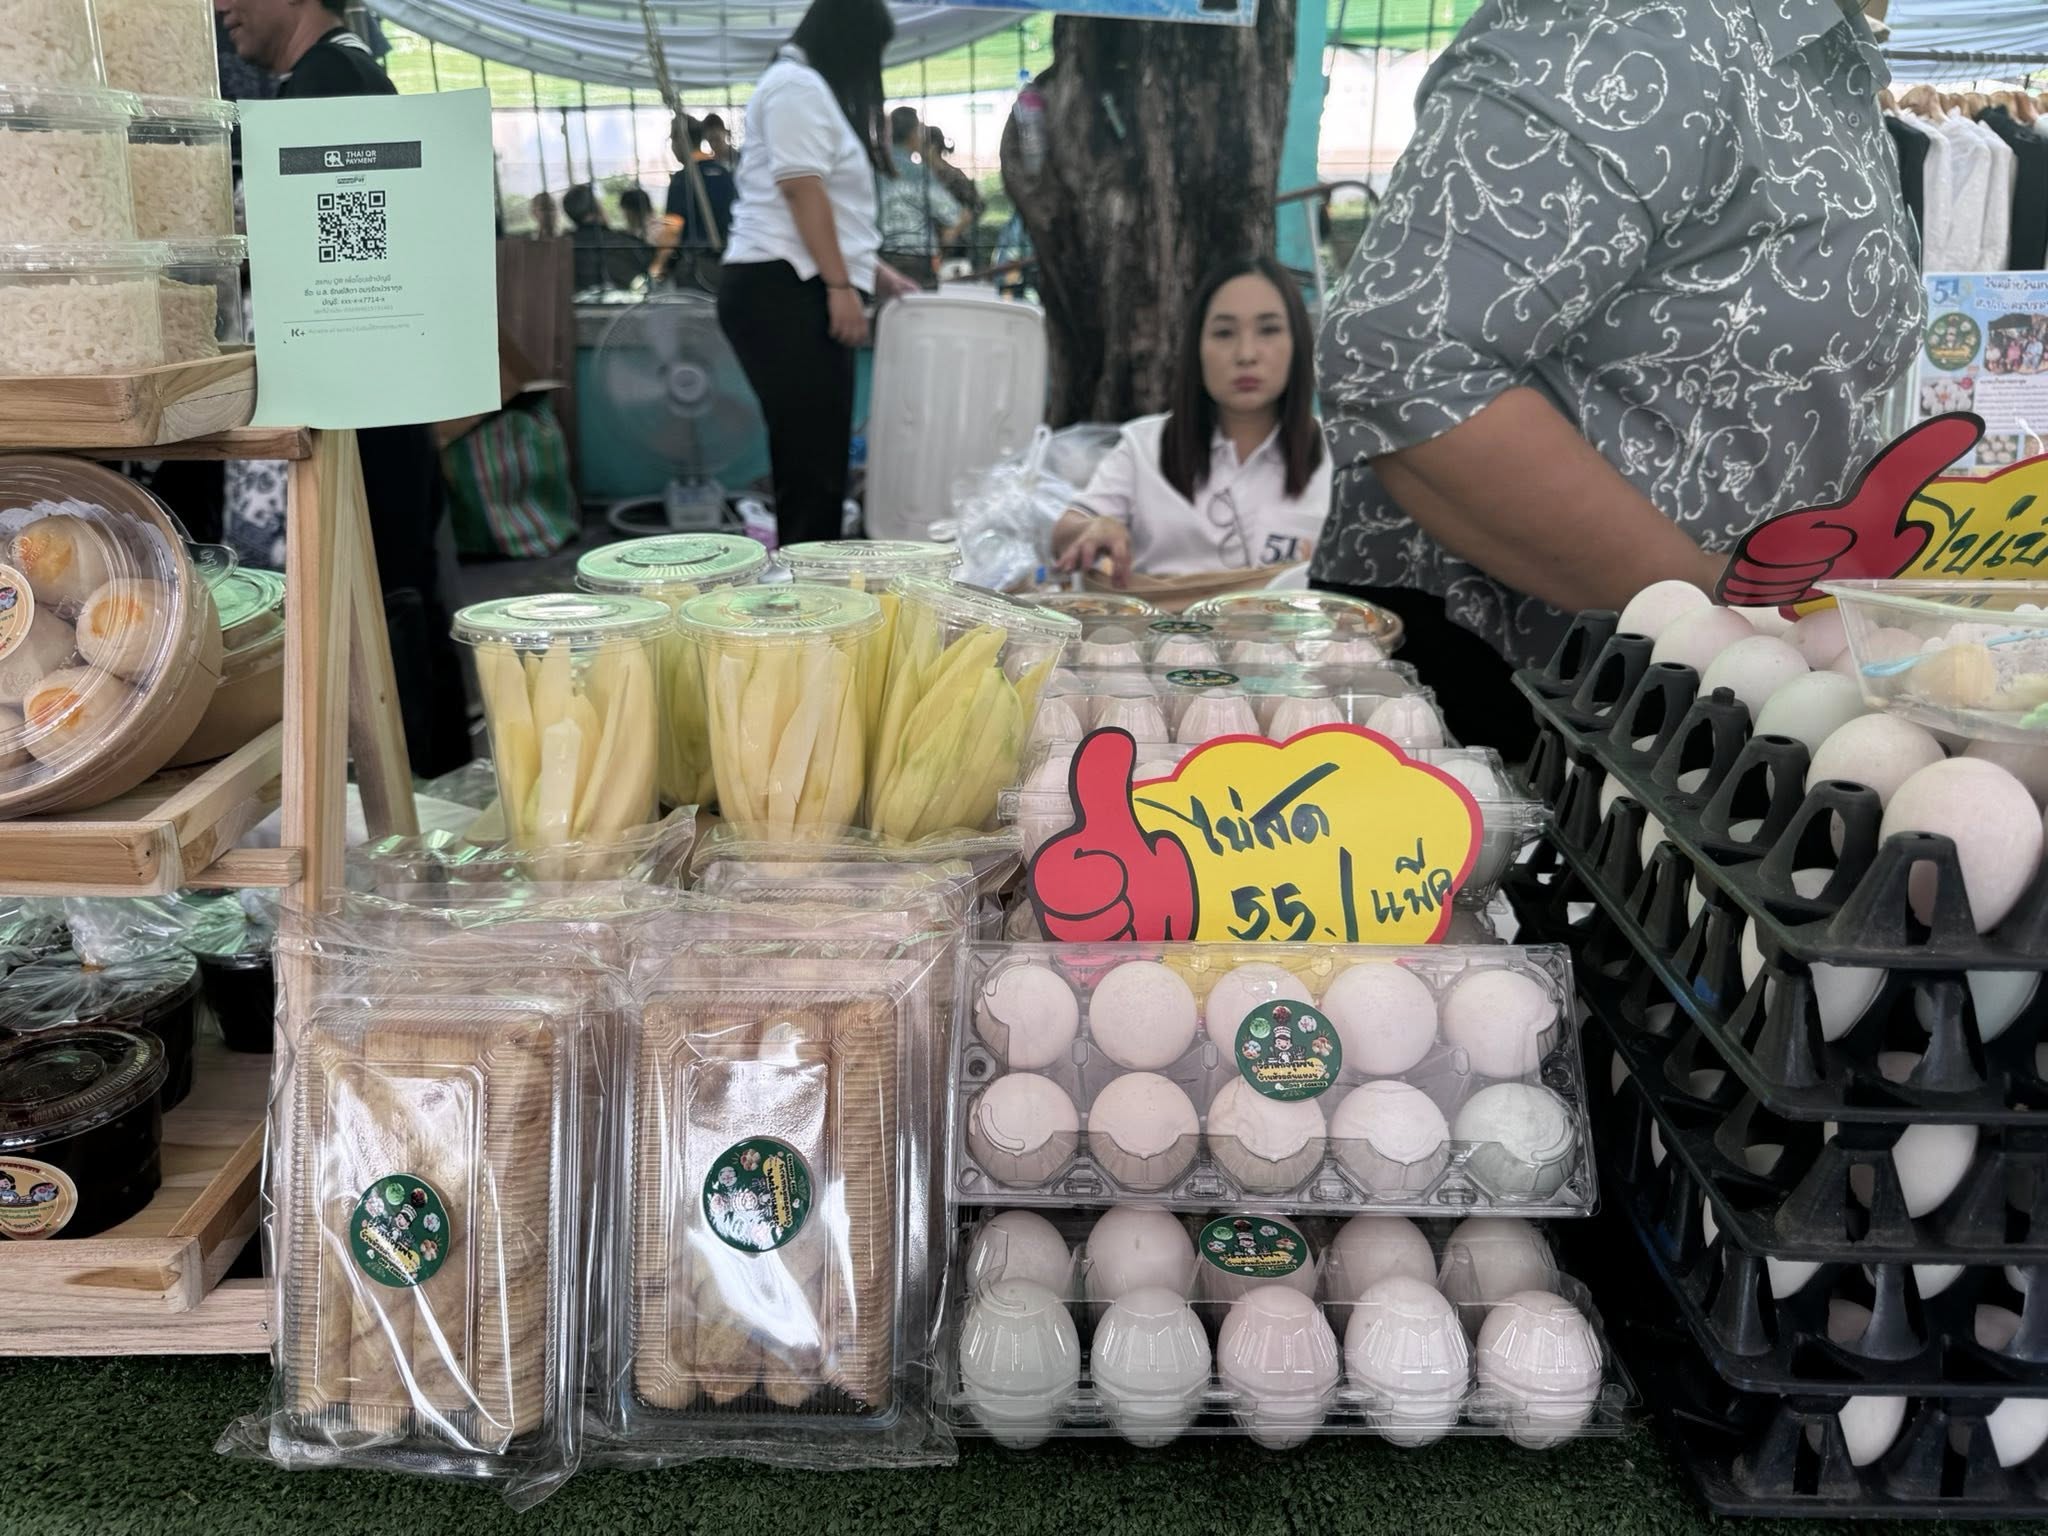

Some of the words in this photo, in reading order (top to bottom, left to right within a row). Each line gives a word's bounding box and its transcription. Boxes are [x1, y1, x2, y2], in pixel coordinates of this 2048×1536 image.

[346, 157, 377, 165] PAYMENT
[291, 328, 306, 337] K+
[1134, 762, 1340, 856] ไข่สด
